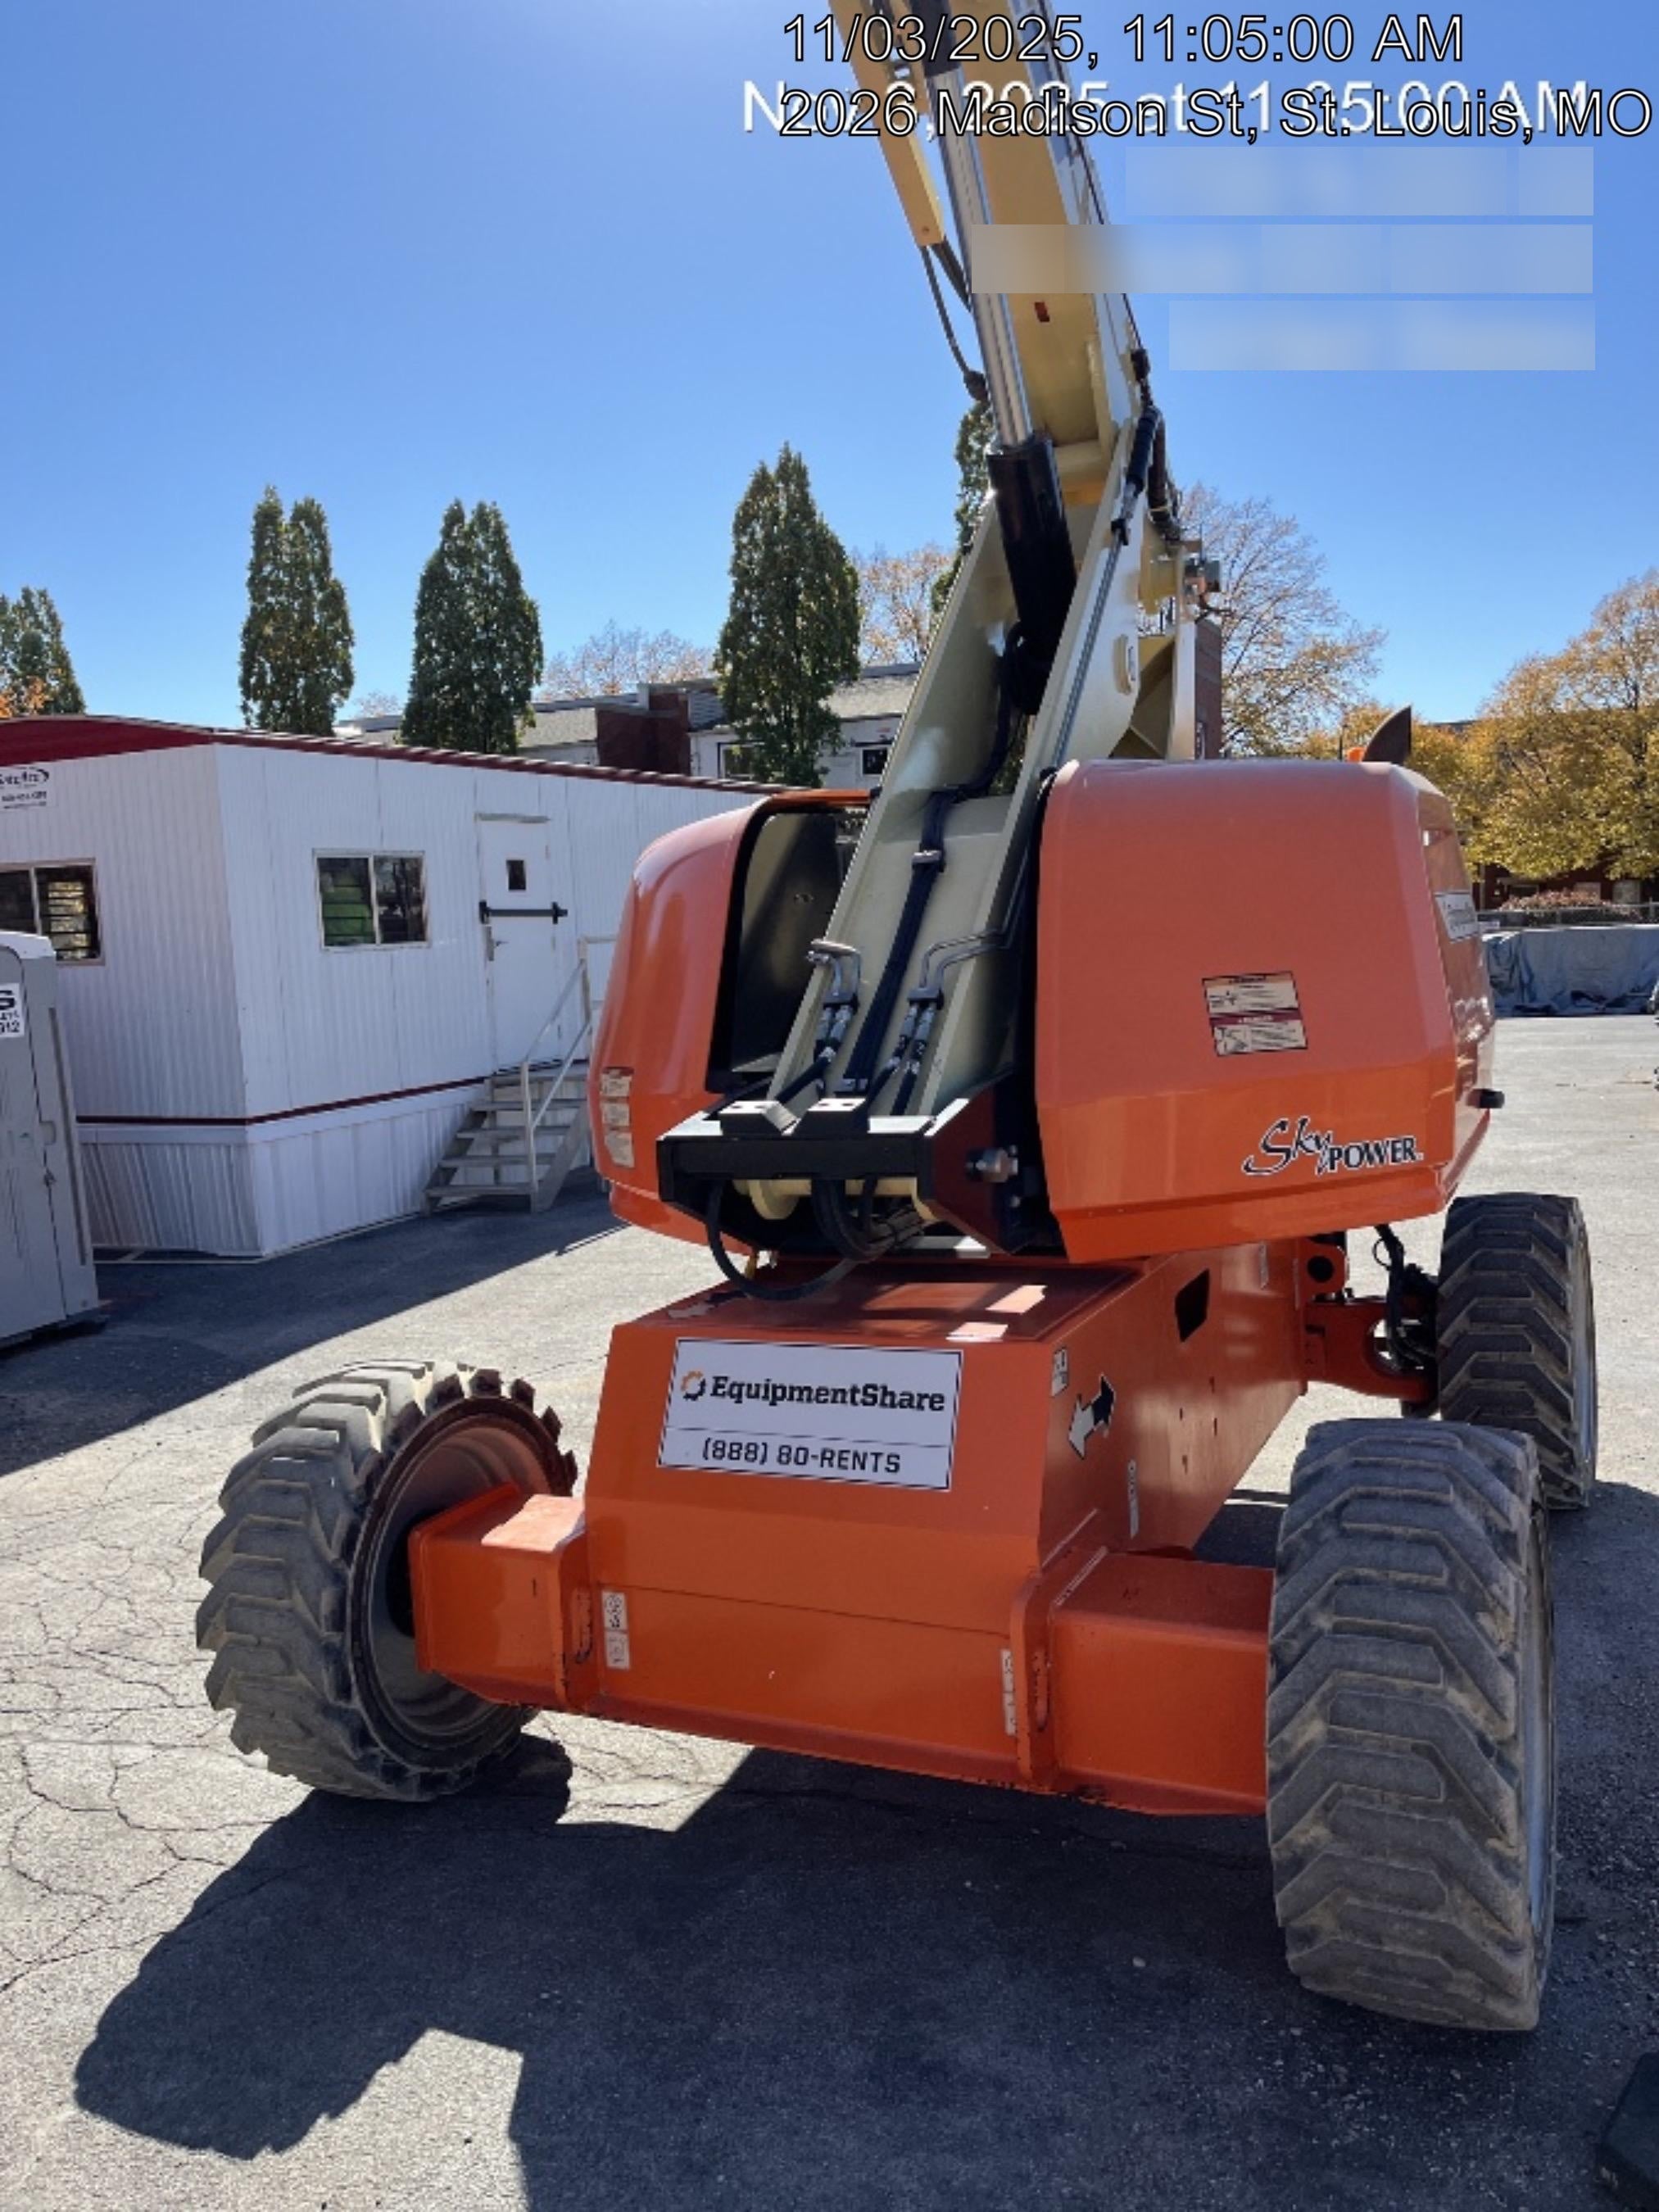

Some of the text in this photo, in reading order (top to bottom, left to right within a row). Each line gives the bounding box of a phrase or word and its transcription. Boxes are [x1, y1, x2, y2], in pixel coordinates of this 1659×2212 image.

[1326, 1135, 1417, 1172] POWER
[709, 1375, 945, 1412] EquipmentShare
[702, 1437, 901, 1474] (888) 80-RENTS
